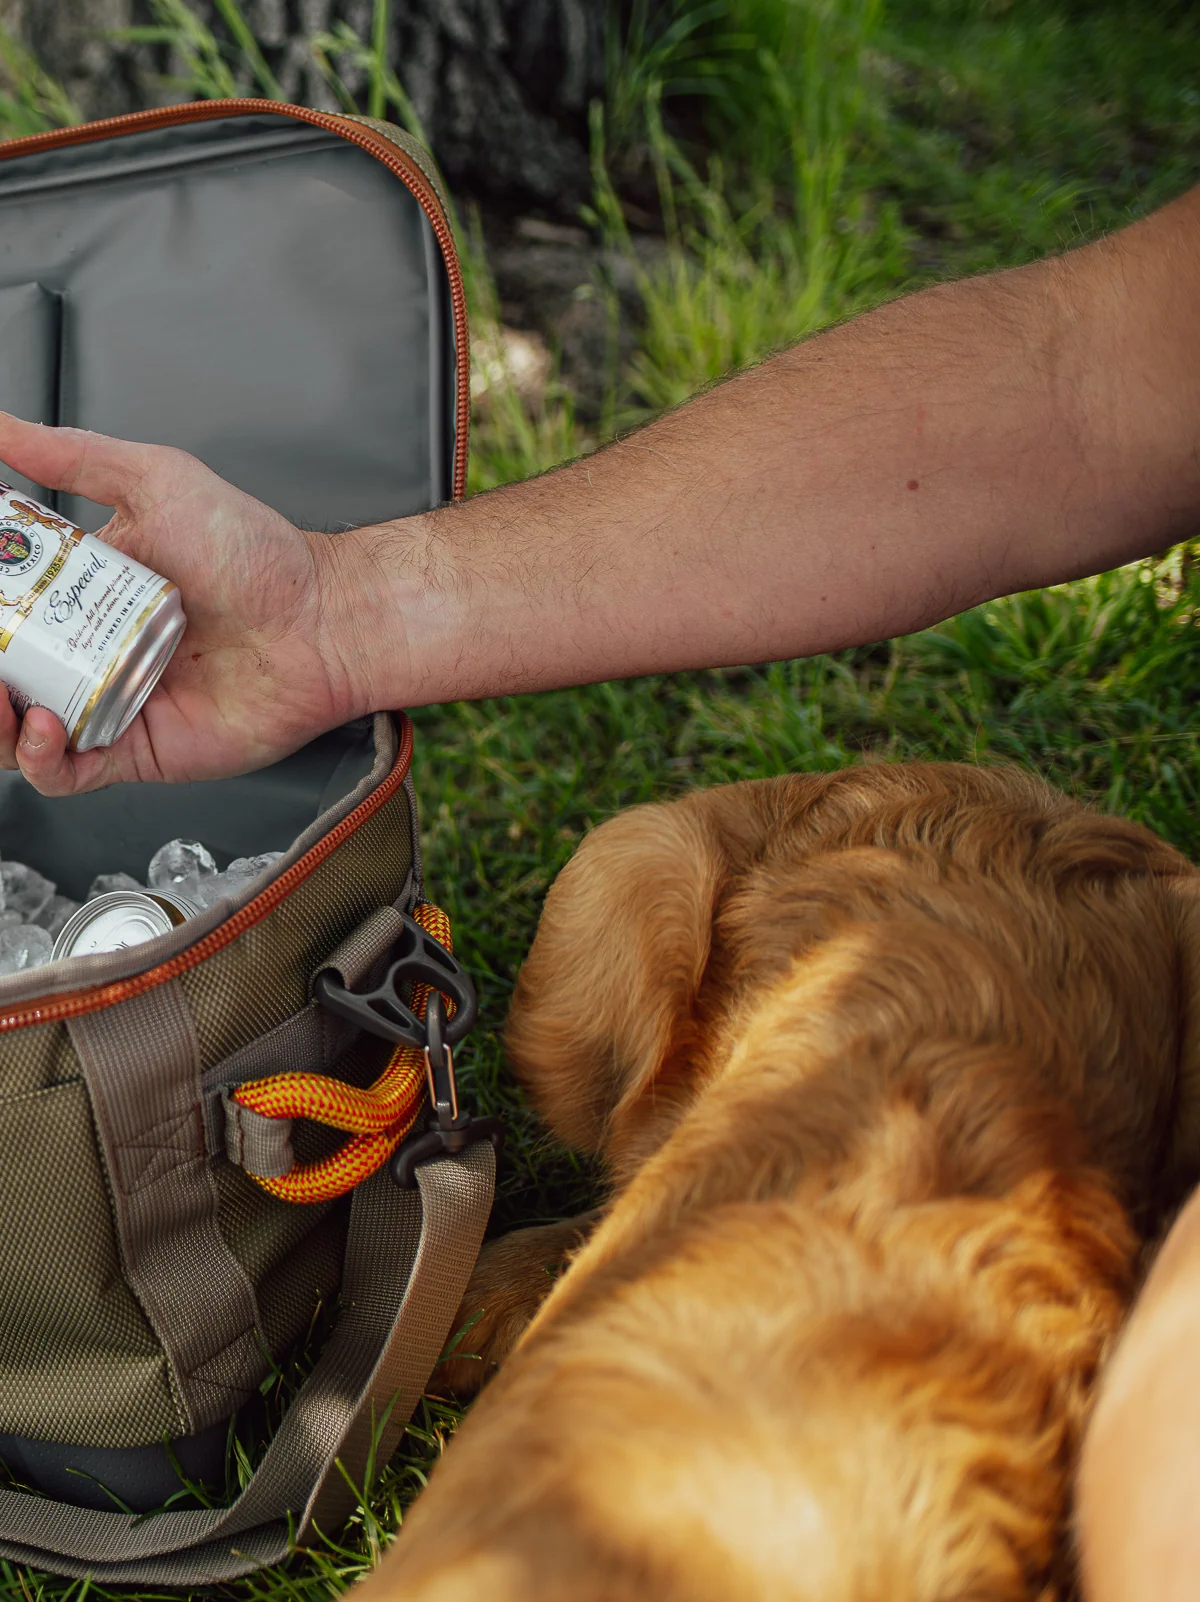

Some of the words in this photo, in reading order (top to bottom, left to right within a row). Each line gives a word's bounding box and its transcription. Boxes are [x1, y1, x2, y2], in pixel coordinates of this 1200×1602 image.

[46, 562, 61, 579] 1925
[120, 607, 129, 616] IN
[93, 617, 104, 632] with
